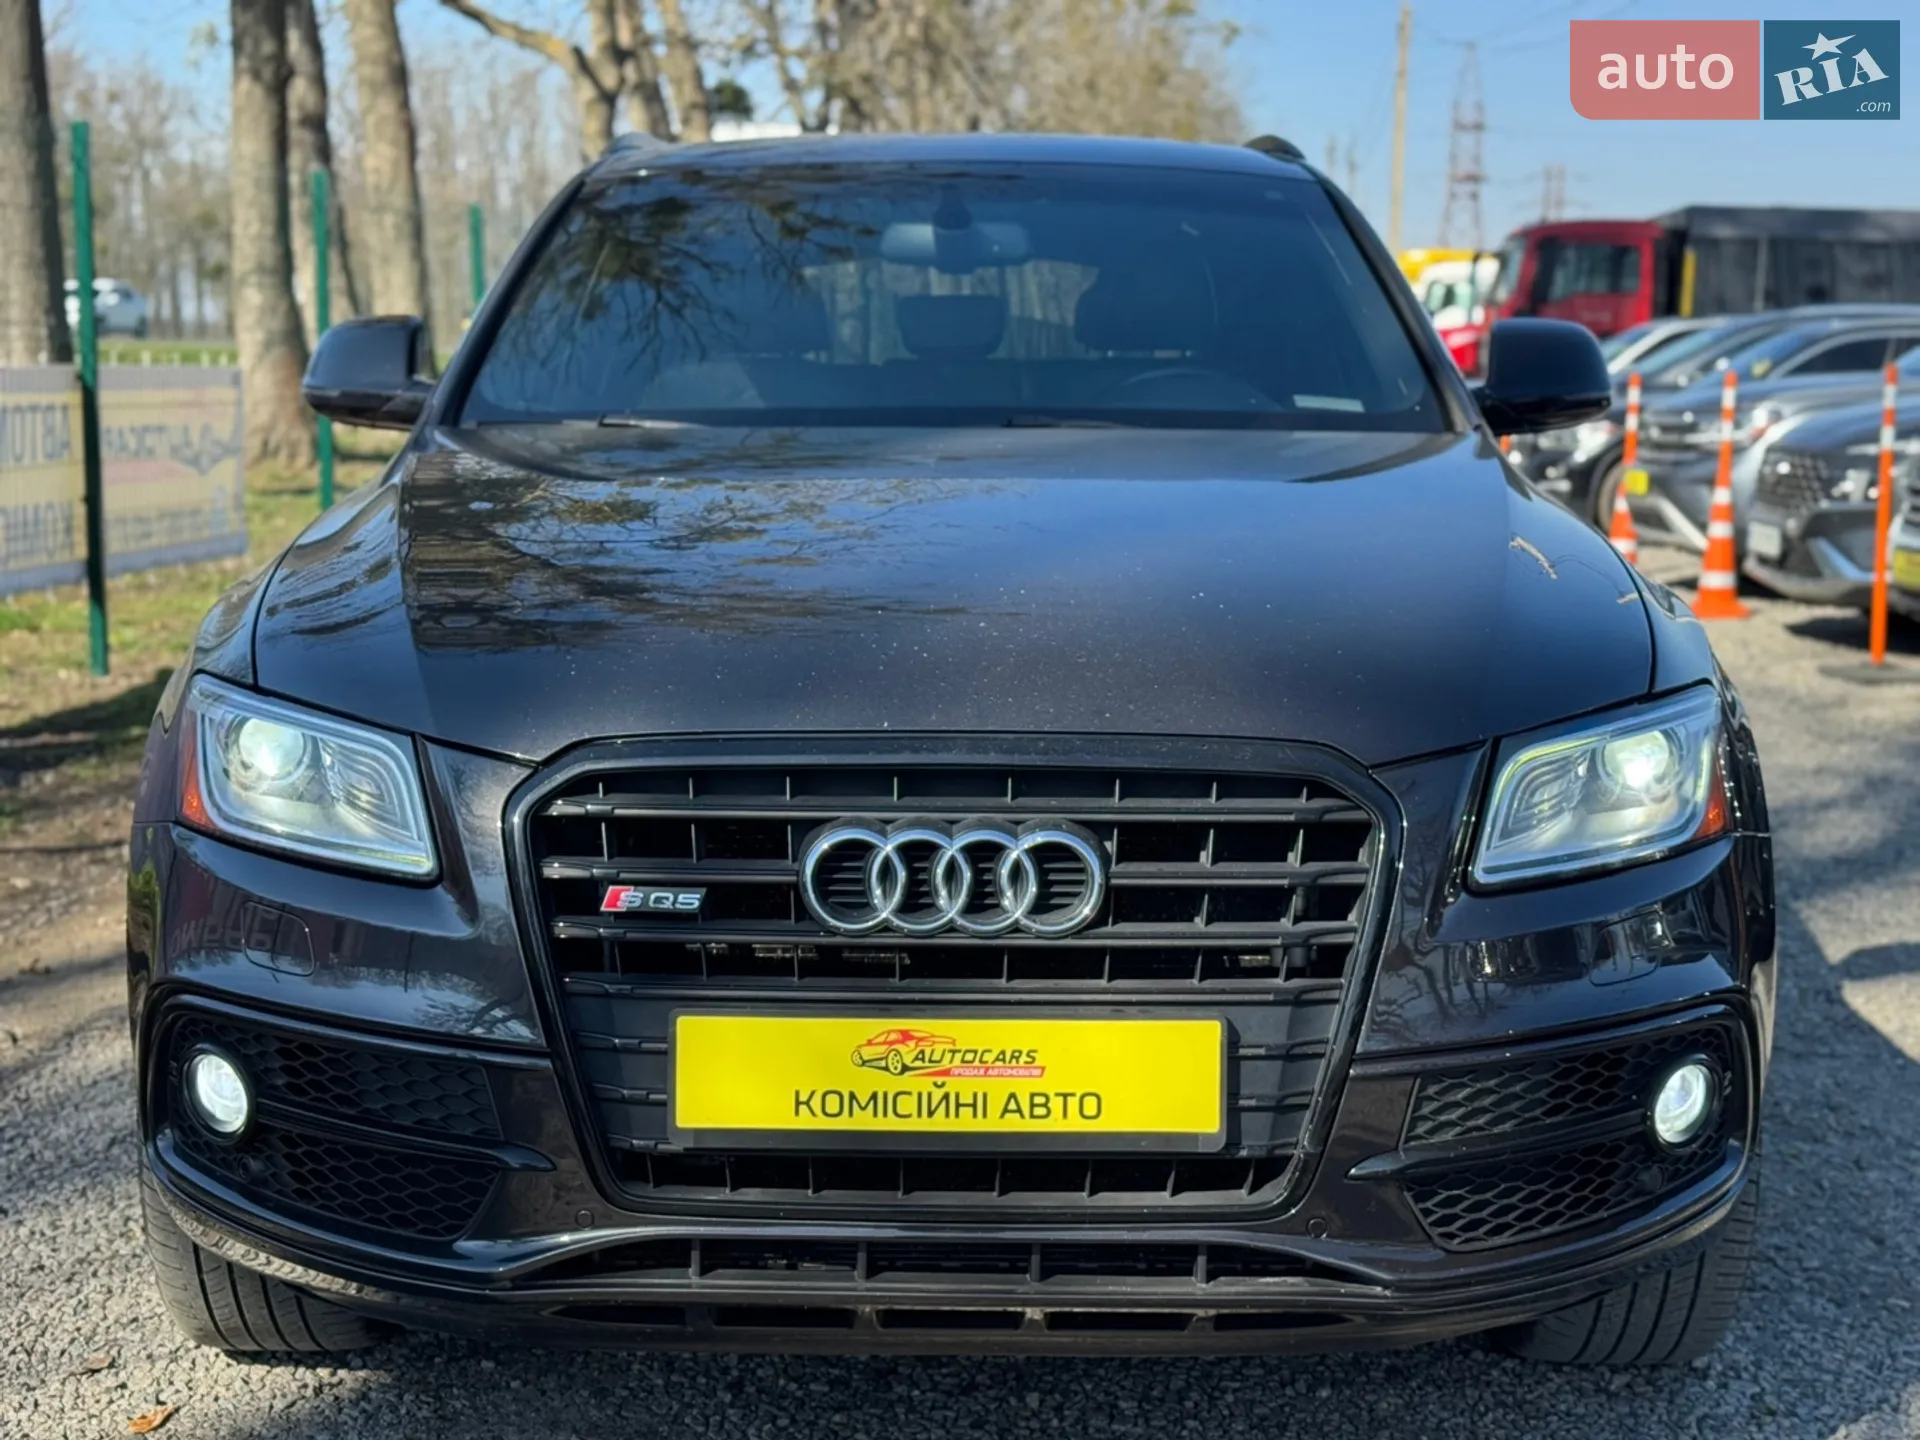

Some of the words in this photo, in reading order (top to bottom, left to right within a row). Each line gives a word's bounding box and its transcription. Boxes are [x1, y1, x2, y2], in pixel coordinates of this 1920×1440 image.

[910, 1048, 1038, 1064] AUTOCARS
[794, 1080, 987, 1119] КОМІСІЙНІ
[999, 1092, 1102, 1120] АВТО
